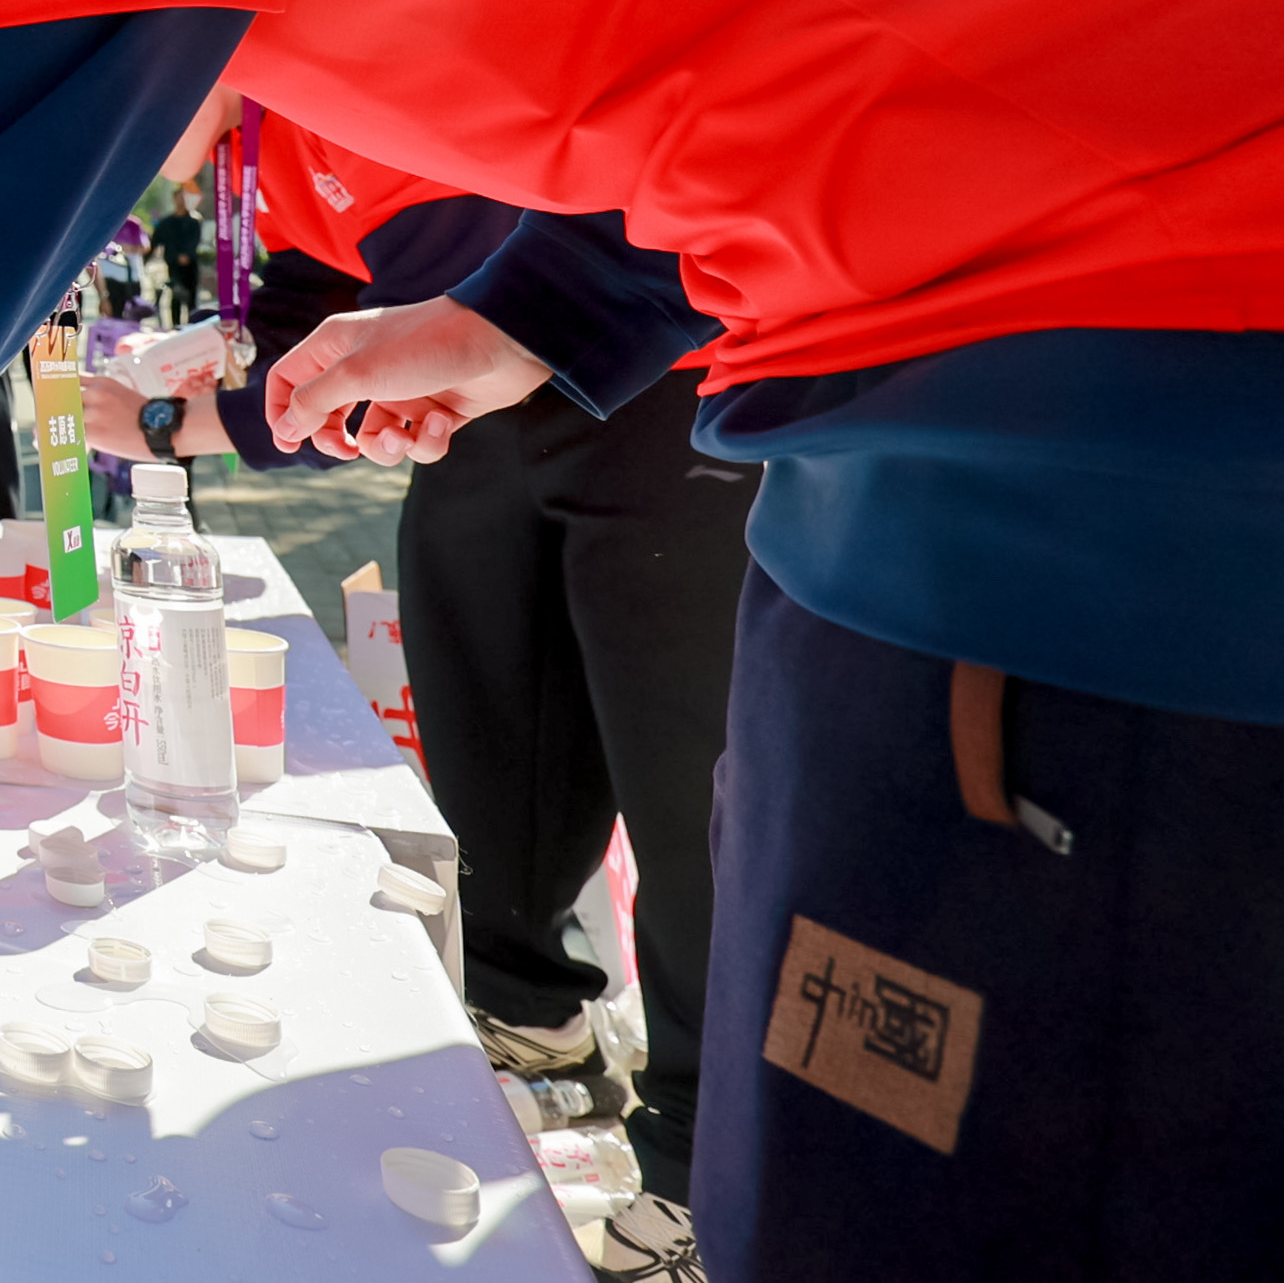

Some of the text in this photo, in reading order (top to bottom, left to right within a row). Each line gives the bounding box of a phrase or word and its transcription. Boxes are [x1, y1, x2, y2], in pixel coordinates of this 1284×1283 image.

[48, 414, 76, 447] 志愿者
[51, 457, 79, 476] VOLUNTEER
